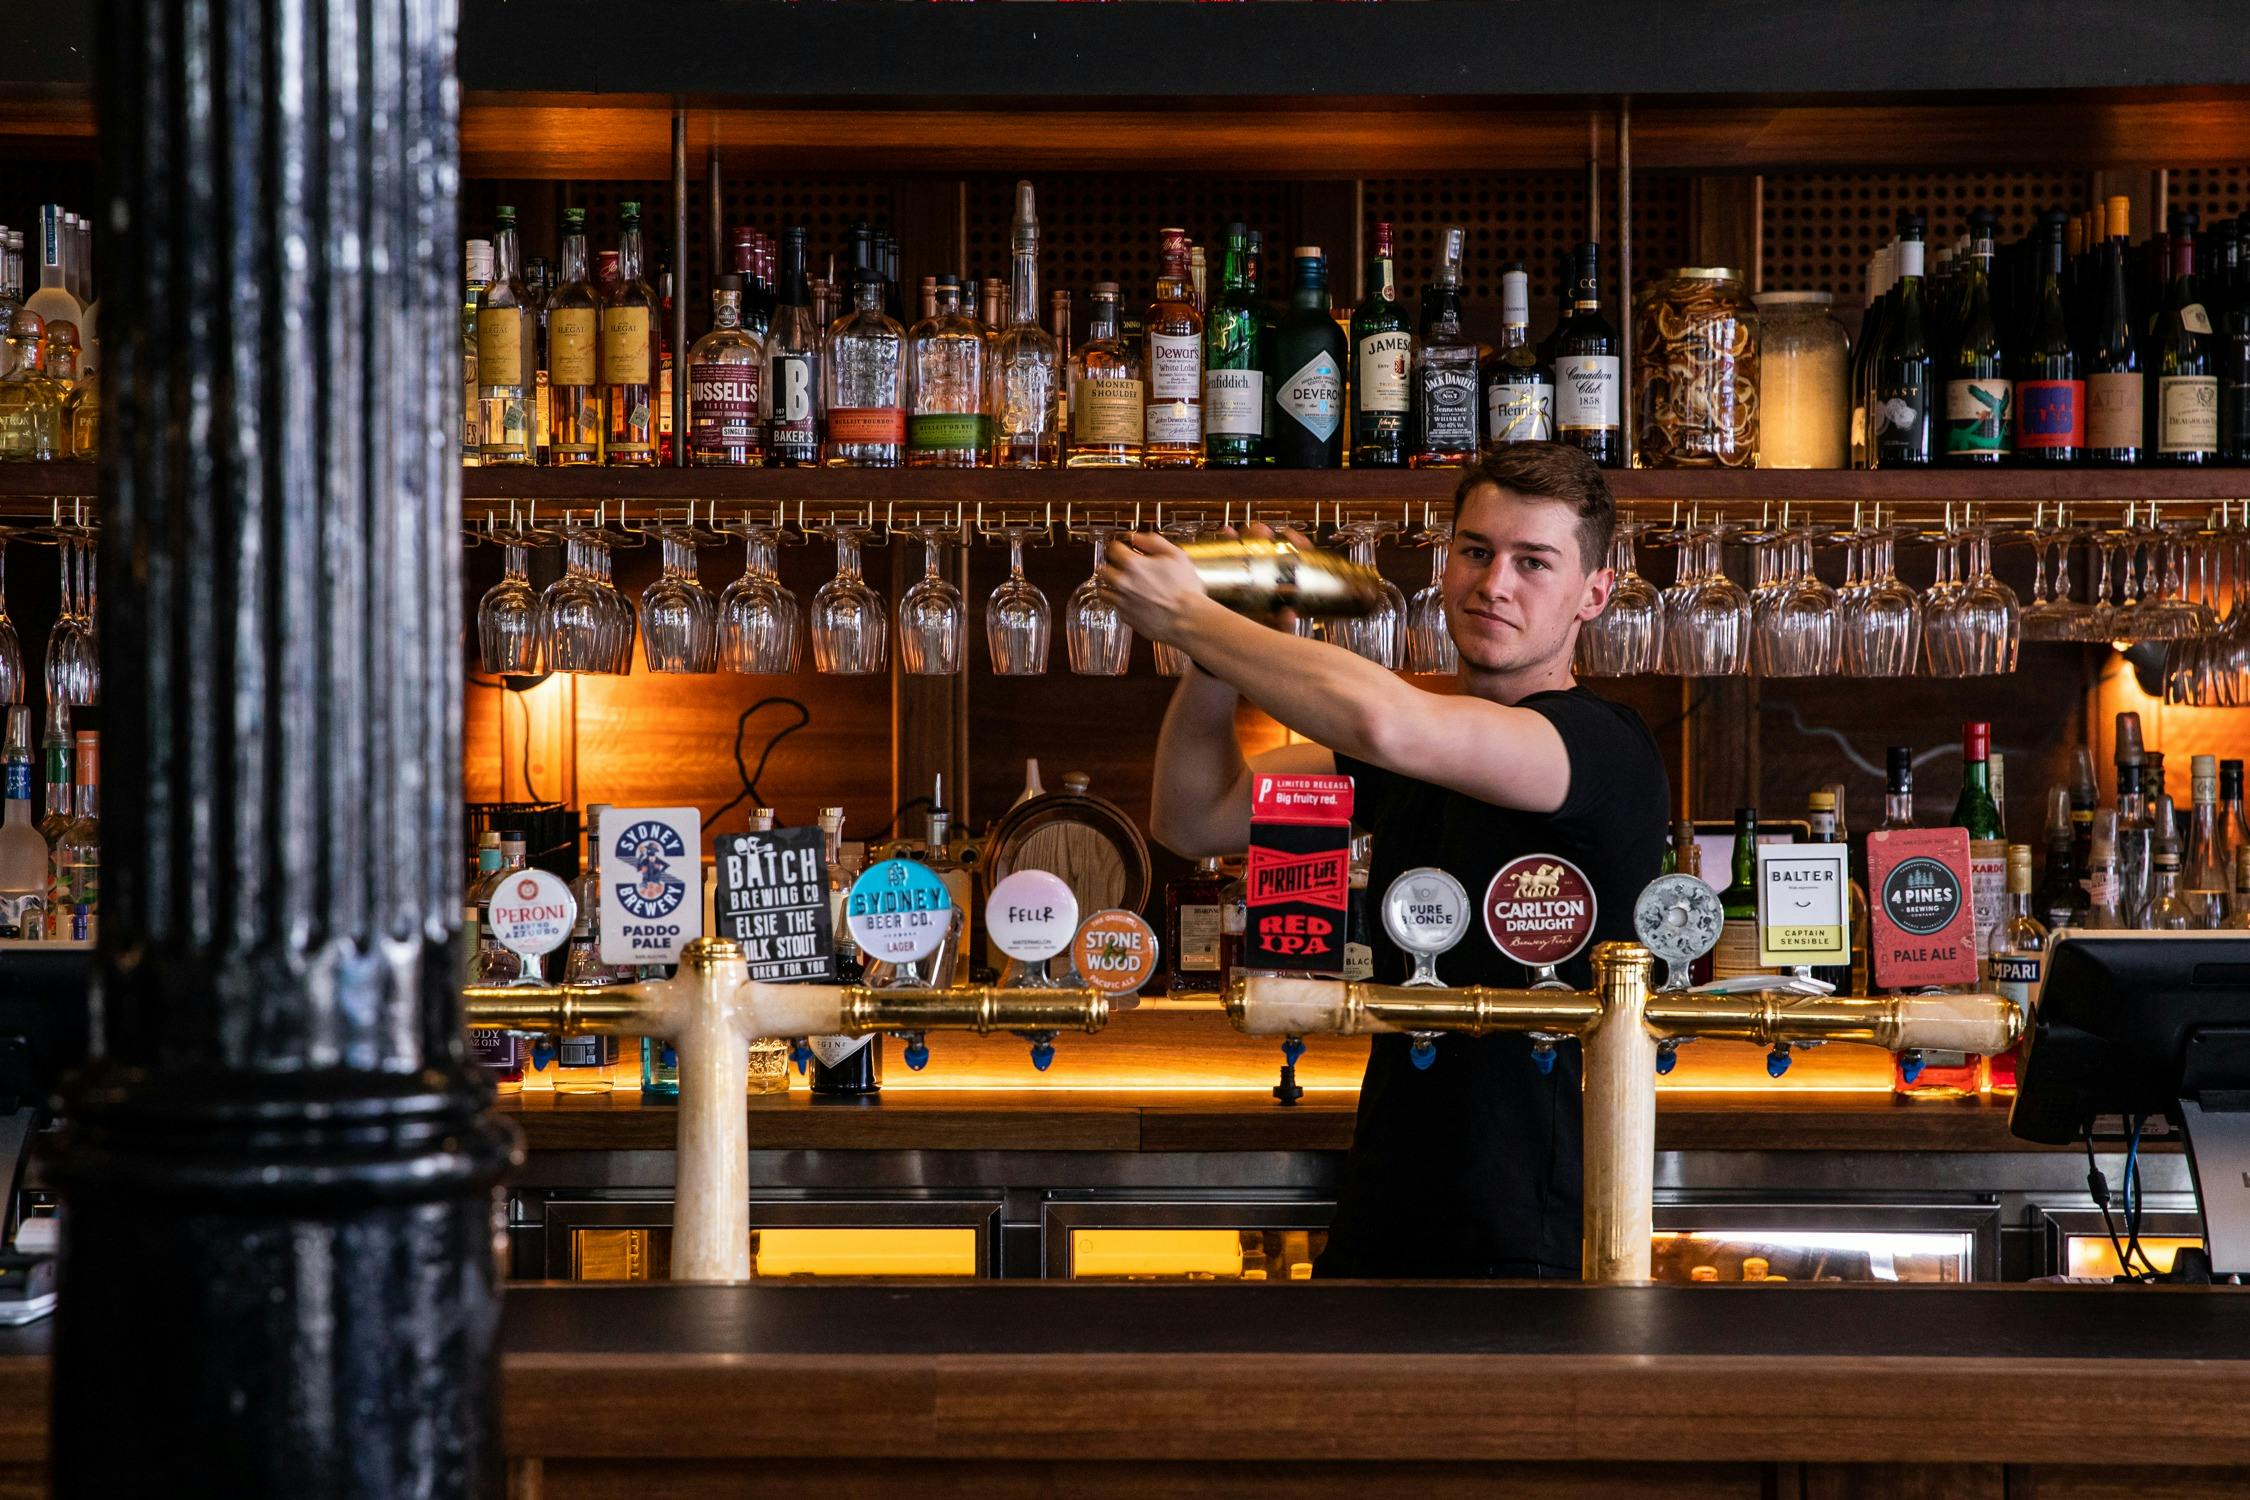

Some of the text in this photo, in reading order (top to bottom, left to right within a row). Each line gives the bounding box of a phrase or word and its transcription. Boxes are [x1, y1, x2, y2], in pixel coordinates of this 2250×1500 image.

[1156, 345, 1199, 359] Dewar's
[1565, 366, 1612, 381] Canadian
[1096, 380, 1135, 389] MONKEY
[1425, 372, 1476, 392] JACK DANIEL'S
[1576, 381, 1602, 394] Club
[691, 381, 758, 402] RUSSELL'S
[785, 359, 810, 421] B
[1293, 388, 1340, 400] DEVERO
[704, 402, 740, 410] RESERVE
[1433, 404, 1468, 413] Tennessee
[1579, 396, 1600, 406] 1858
[723, 427, 745, 435] SINGLE
[774, 430, 814, 442] BAKER'S
[1277, 780, 1349, 789] LIMITED RELEASE
[1276, 793, 1338, 806] Big fruity red.
[620, 824, 680, 851] SYDNEY
[727, 847, 818, 890] BATCH
[1772, 871, 1833, 881] BALTER
[620, 885, 681, 916] BREWERY
[730, 884, 819, 910] BREWING CO
[855, 888, 942, 914] SYDNEY
[1891, 888, 1953, 904] 4 PINES
[496, 904, 564, 924] PERONI
[1009, 907, 1054, 923] FELLR
[1409, 904, 1443, 915] PURE
[1494, 900, 1584, 919] CARLTON
[1906, 905, 1940, 913] BREWING
[736, 910, 815, 938] ELSIE THE
[866, 912, 933, 929] BEER CO.
[1259, 914, 1333, 935] RED
[1506, 918, 1575, 933] DRAUGHT
[623, 925, 680, 936] PADDO
[632, 938, 671, 948] PALE
[776, 934, 816, 958] STOUT
[887, 942, 915, 952] LAGER
[1086, 931, 1141, 949] STONE
[1259, 935, 1331, 955] IPA
[1509, 935, 1573, 951] Brewery Fresh
[1086, 954, 1141, 971] WOOD
[1894, 948, 1956, 962] PALE ALE
[784, 963, 802, 976] FOR
[807, 960, 825, 974] YOU
[1090, 975, 1136, 988] PACIFIC ALE
[481, 1039, 500, 1047] GIN
